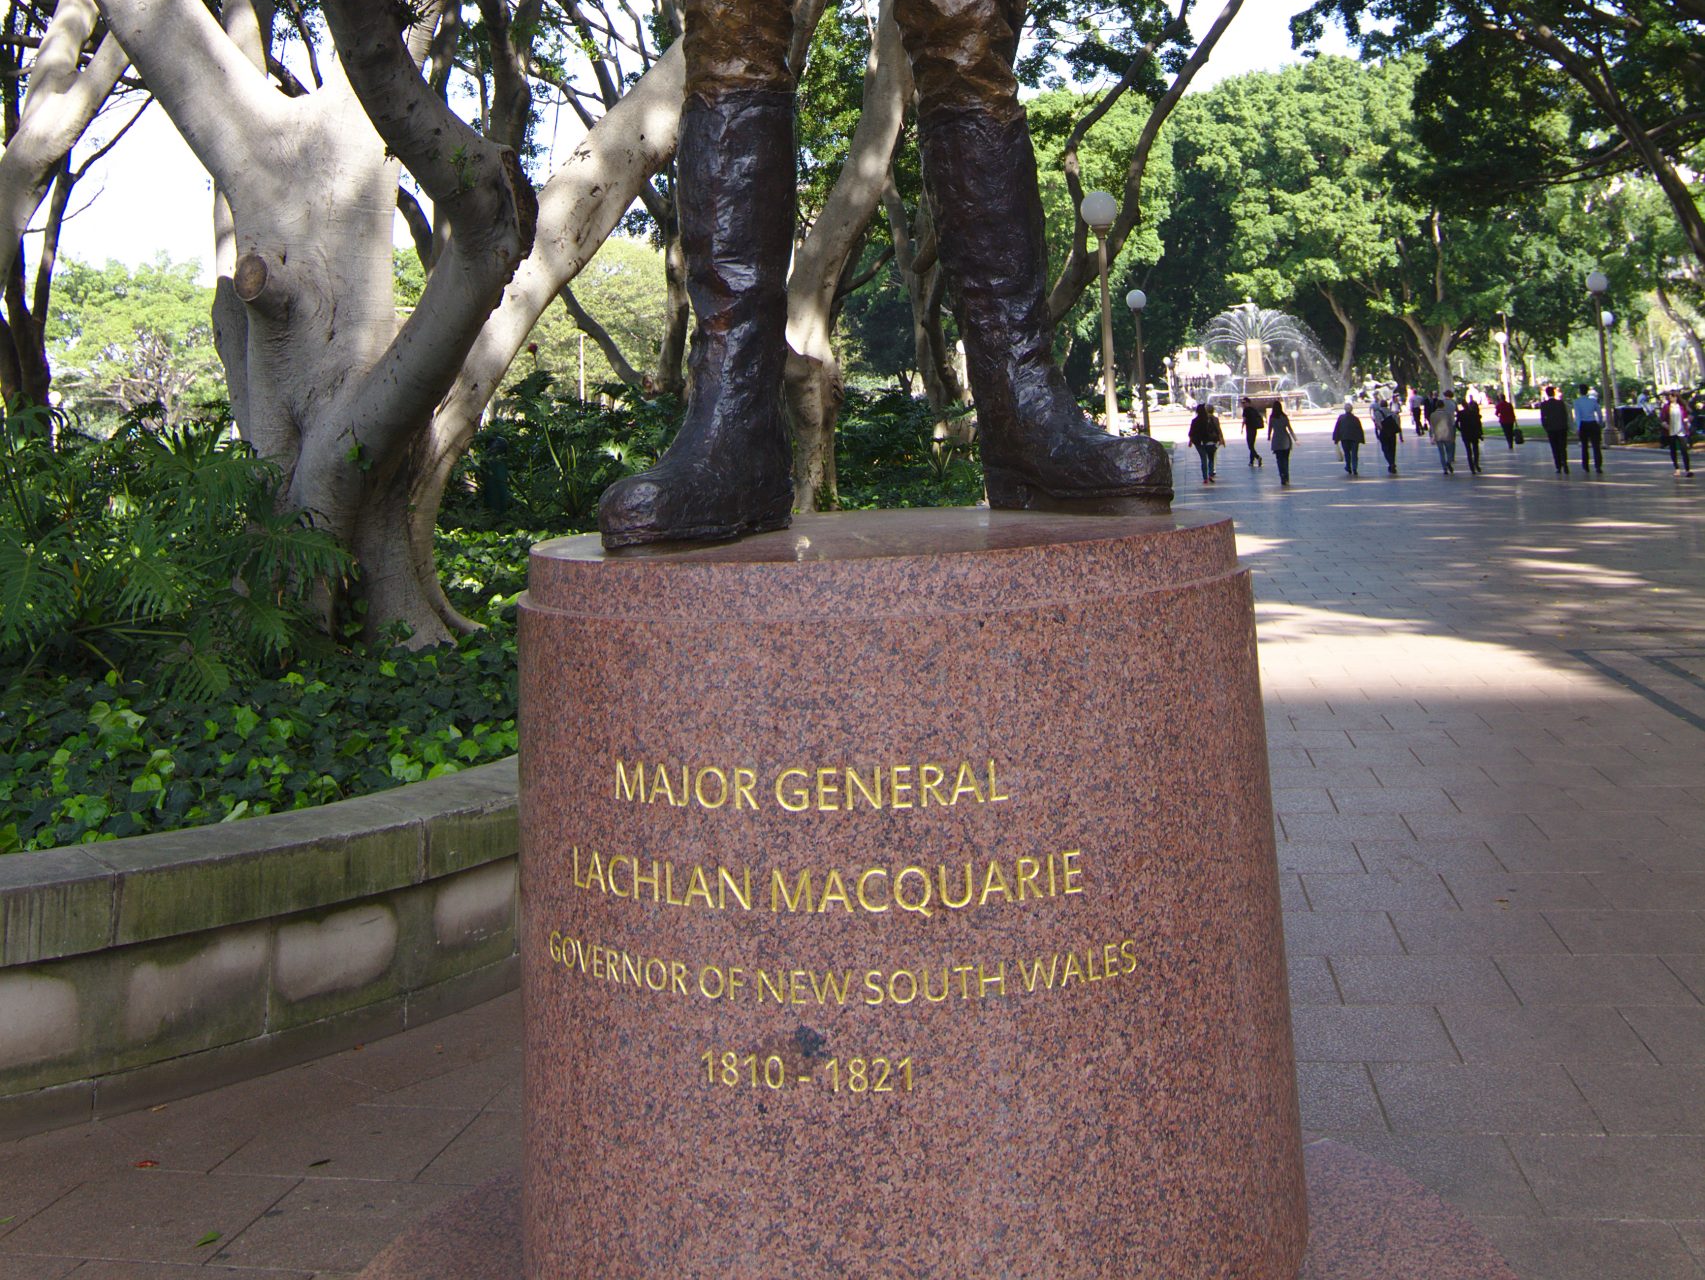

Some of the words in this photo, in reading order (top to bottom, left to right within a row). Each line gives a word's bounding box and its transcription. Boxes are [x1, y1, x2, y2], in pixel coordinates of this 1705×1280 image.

[614, 759, 759, 810] MAJOR
[775, 759, 1009, 812] GENERAL
[573, 846, 752, 911] LACHLAN
[771, 849, 1084, 918] MACQUARIE
[549, 931, 689, 995] GOVERNOR
[700, 966, 745, 1001] OF
[757, 969, 852, 1005] NEW
[865, 963, 1006, 1005] SOUTH
[1019, 939, 1138, 994] WALES
[702, 1051, 786, 1091] 1810
[824, 1056, 915, 1093] 1821
